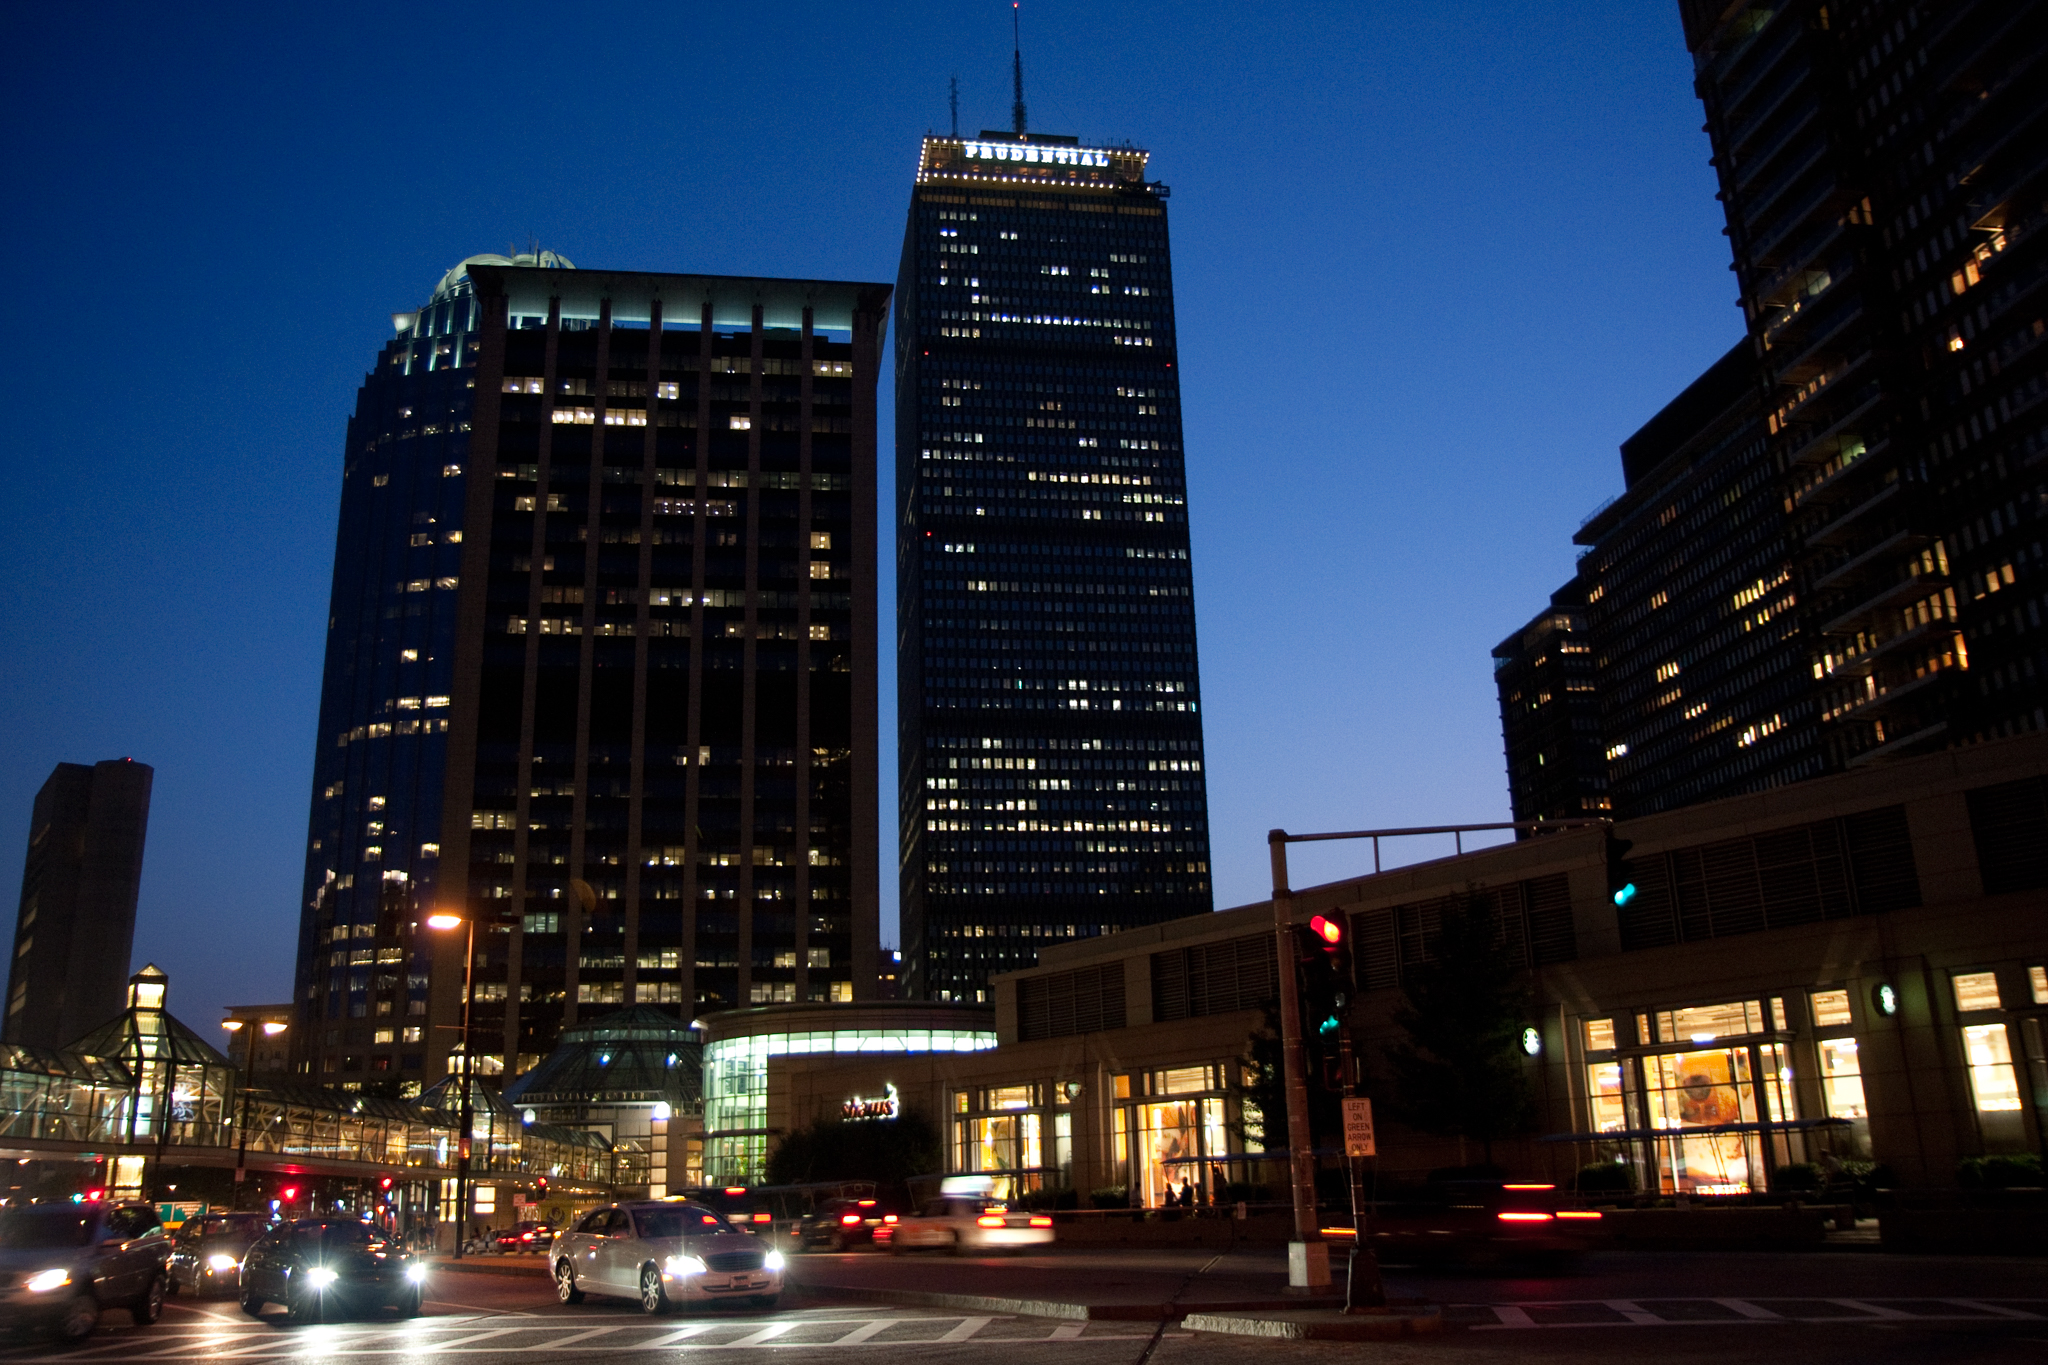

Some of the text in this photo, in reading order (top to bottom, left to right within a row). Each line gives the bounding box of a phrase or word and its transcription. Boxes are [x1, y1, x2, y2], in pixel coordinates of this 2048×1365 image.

[965, 144, 1109, 167] PRUDENTIAL
[1347, 1102, 1365, 1111] LEFT
[1352, 1113, 1363, 1121] ON
[1347, 1122, 1370, 1131] GREEN
[1347, 1133, 1371, 1142] ARROW
[1351, 1143, 1369, 1152] ONLY
